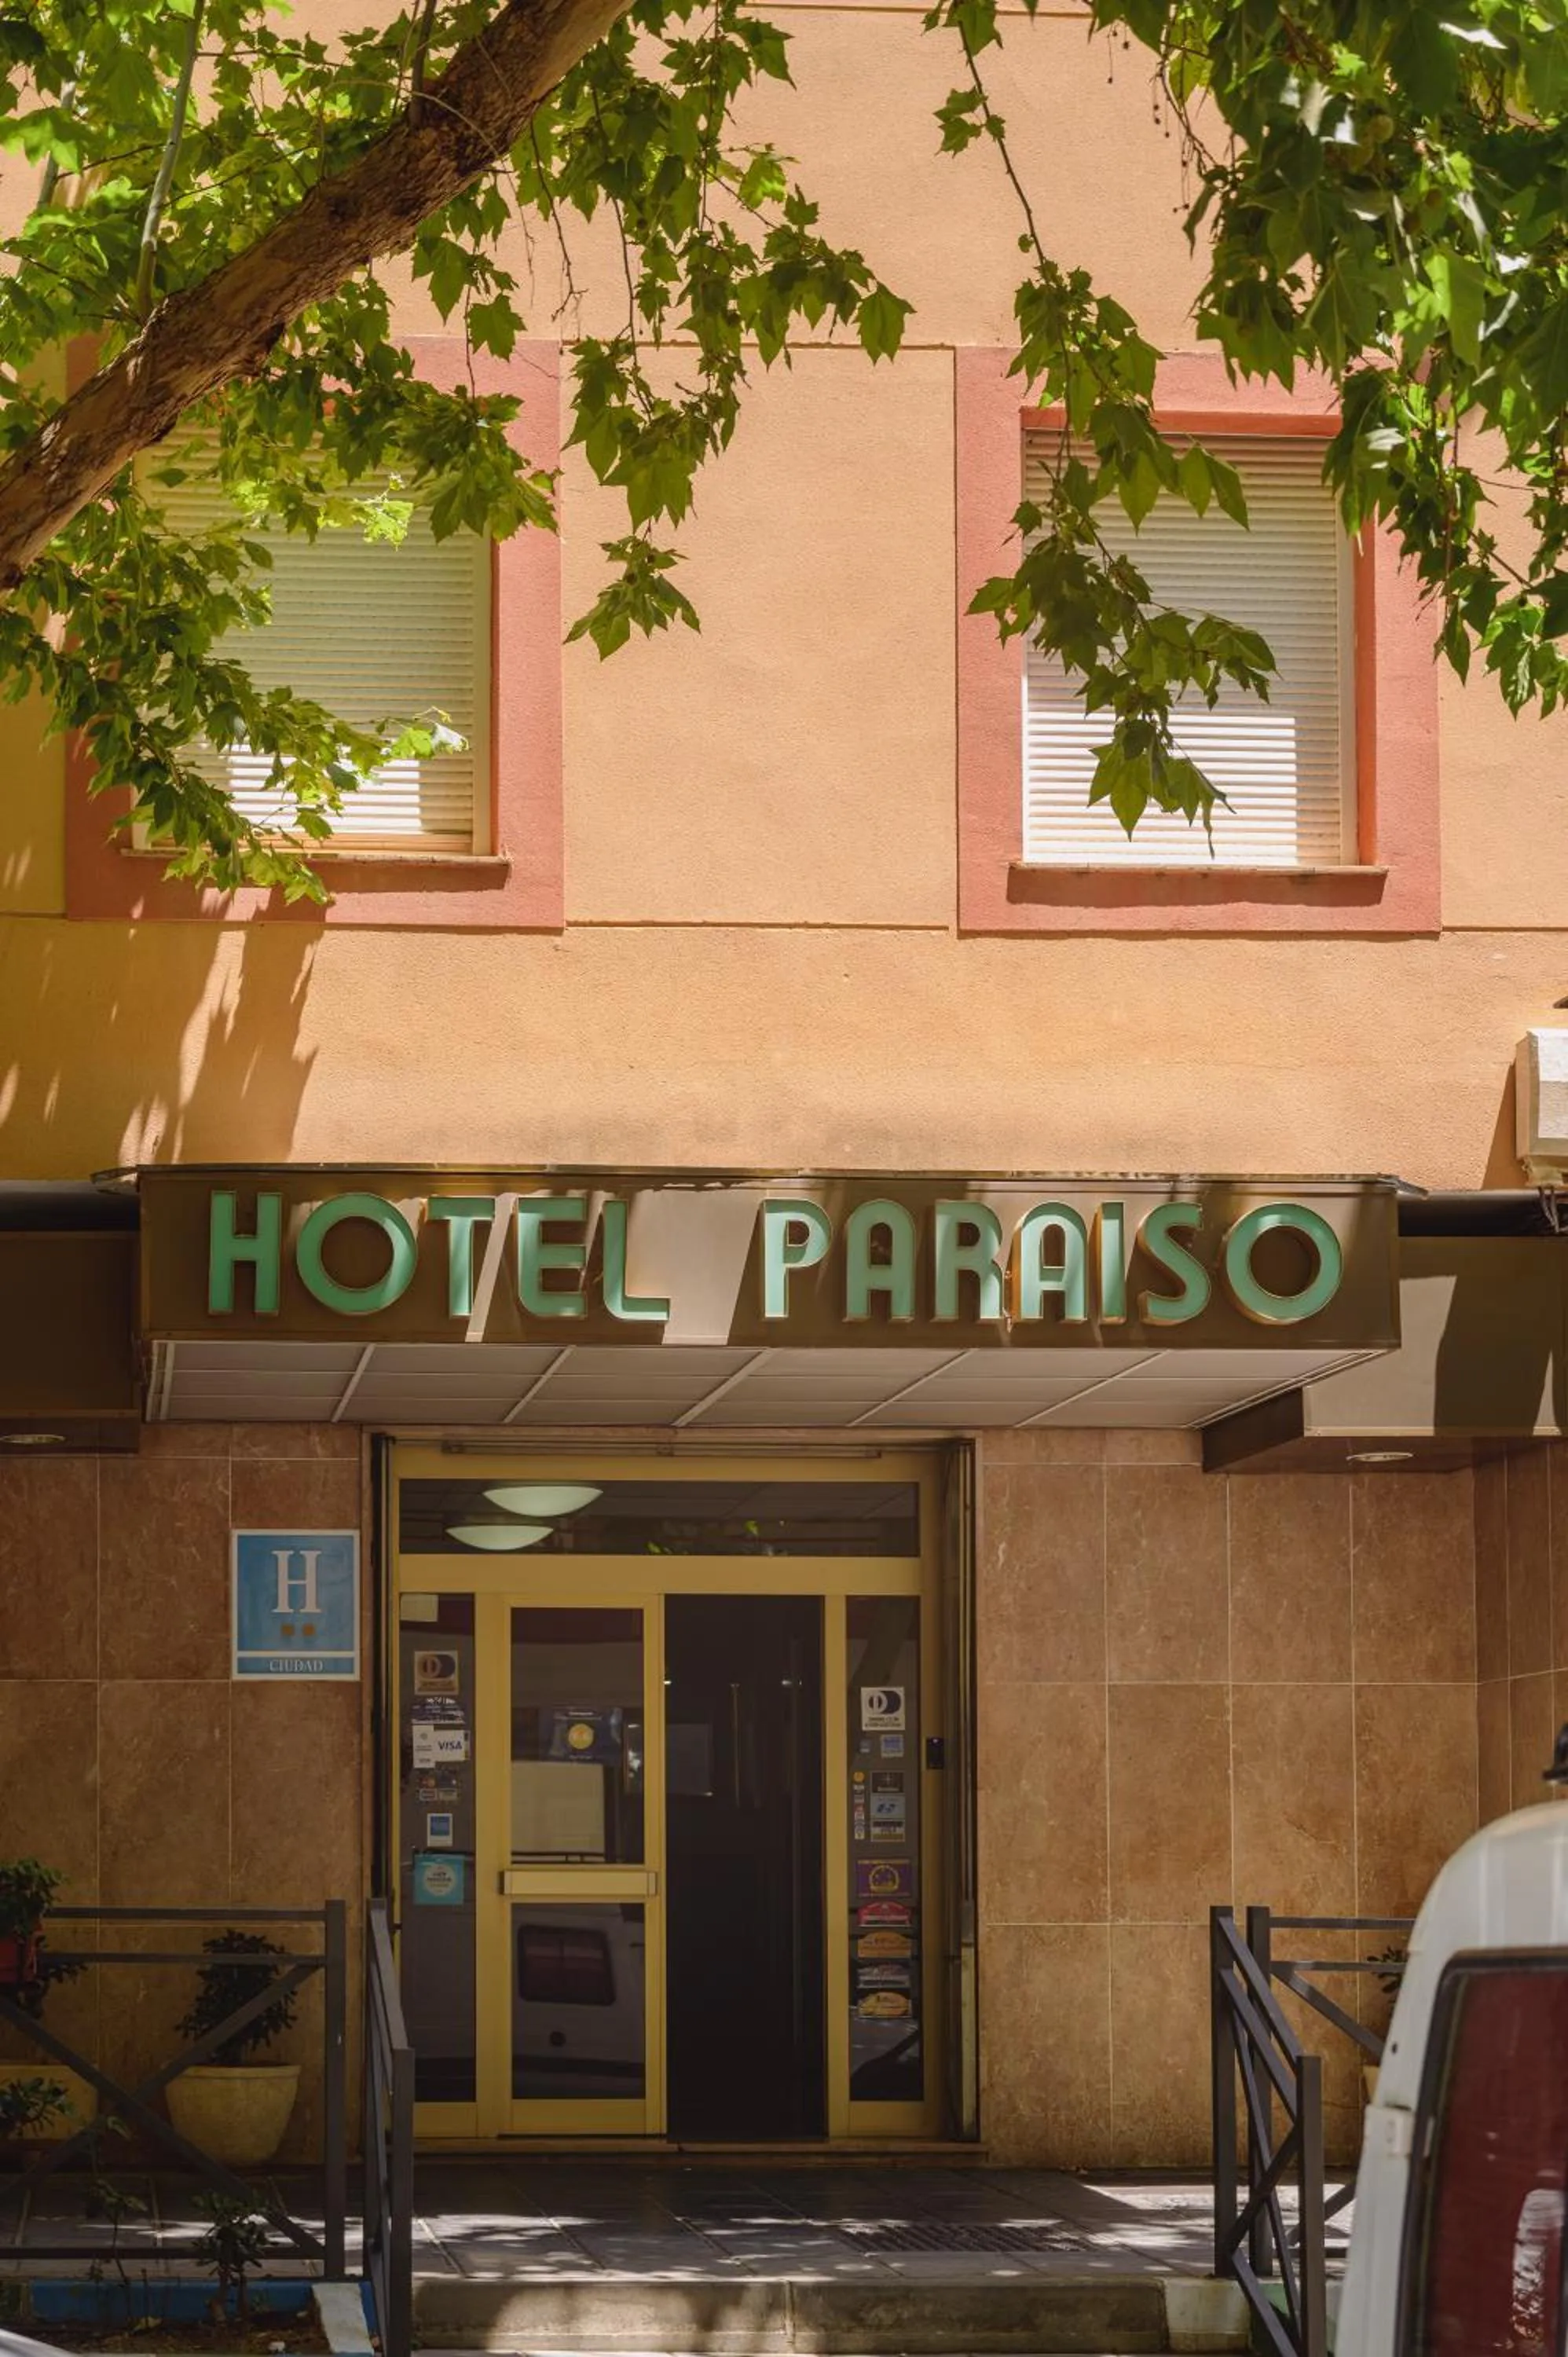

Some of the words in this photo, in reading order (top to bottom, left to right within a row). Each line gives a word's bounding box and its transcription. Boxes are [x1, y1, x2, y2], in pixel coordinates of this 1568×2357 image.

[208, 1190, 671, 1321] HOTEL
[762, 1197, 1343, 1325] PARAISO
[271, 1550, 322, 1613] H
[269, 1659, 323, 1672] CIUDAD
[438, 1740, 462, 1750] VISA
